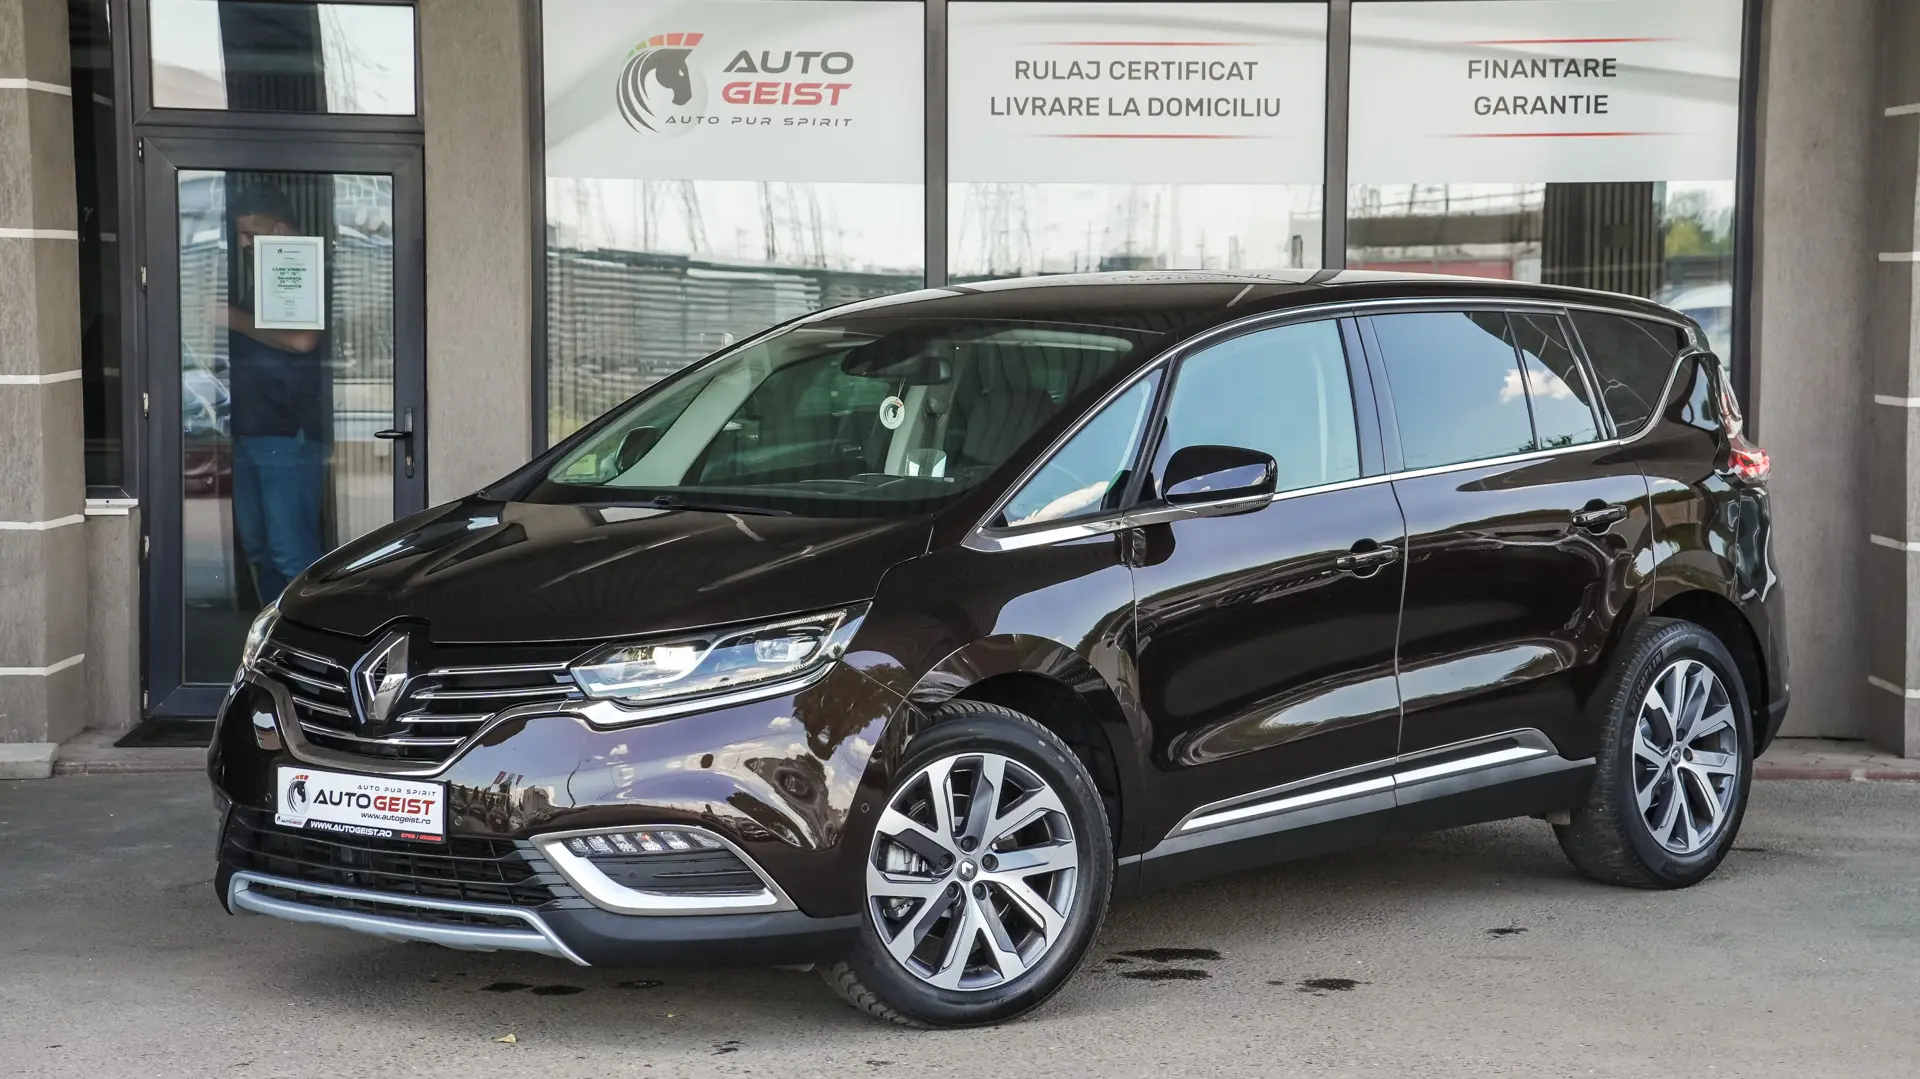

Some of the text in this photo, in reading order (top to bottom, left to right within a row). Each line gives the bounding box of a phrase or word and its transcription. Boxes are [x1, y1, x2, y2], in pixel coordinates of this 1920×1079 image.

[723, 50, 854, 75] AUTO
[1014, 60, 1259, 81] RULAJ CERTIFICAT
[1468, 58, 1617, 79] FINANTARE
[721, 81, 853, 106] GEIST
[990, 96, 1281, 117] LIVRARE LA DOMICILIU
[1474, 95, 1609, 116] GARANTIE
[665, 115, 853, 127] AUTO PUR SPIRIT
[357, 784, 437, 797] AUTO PUR SPIRIT
[310, 820, 393, 838] WWW.AUTOGEIST.RO
[360, 812, 431, 825] www.autogeist.ro
